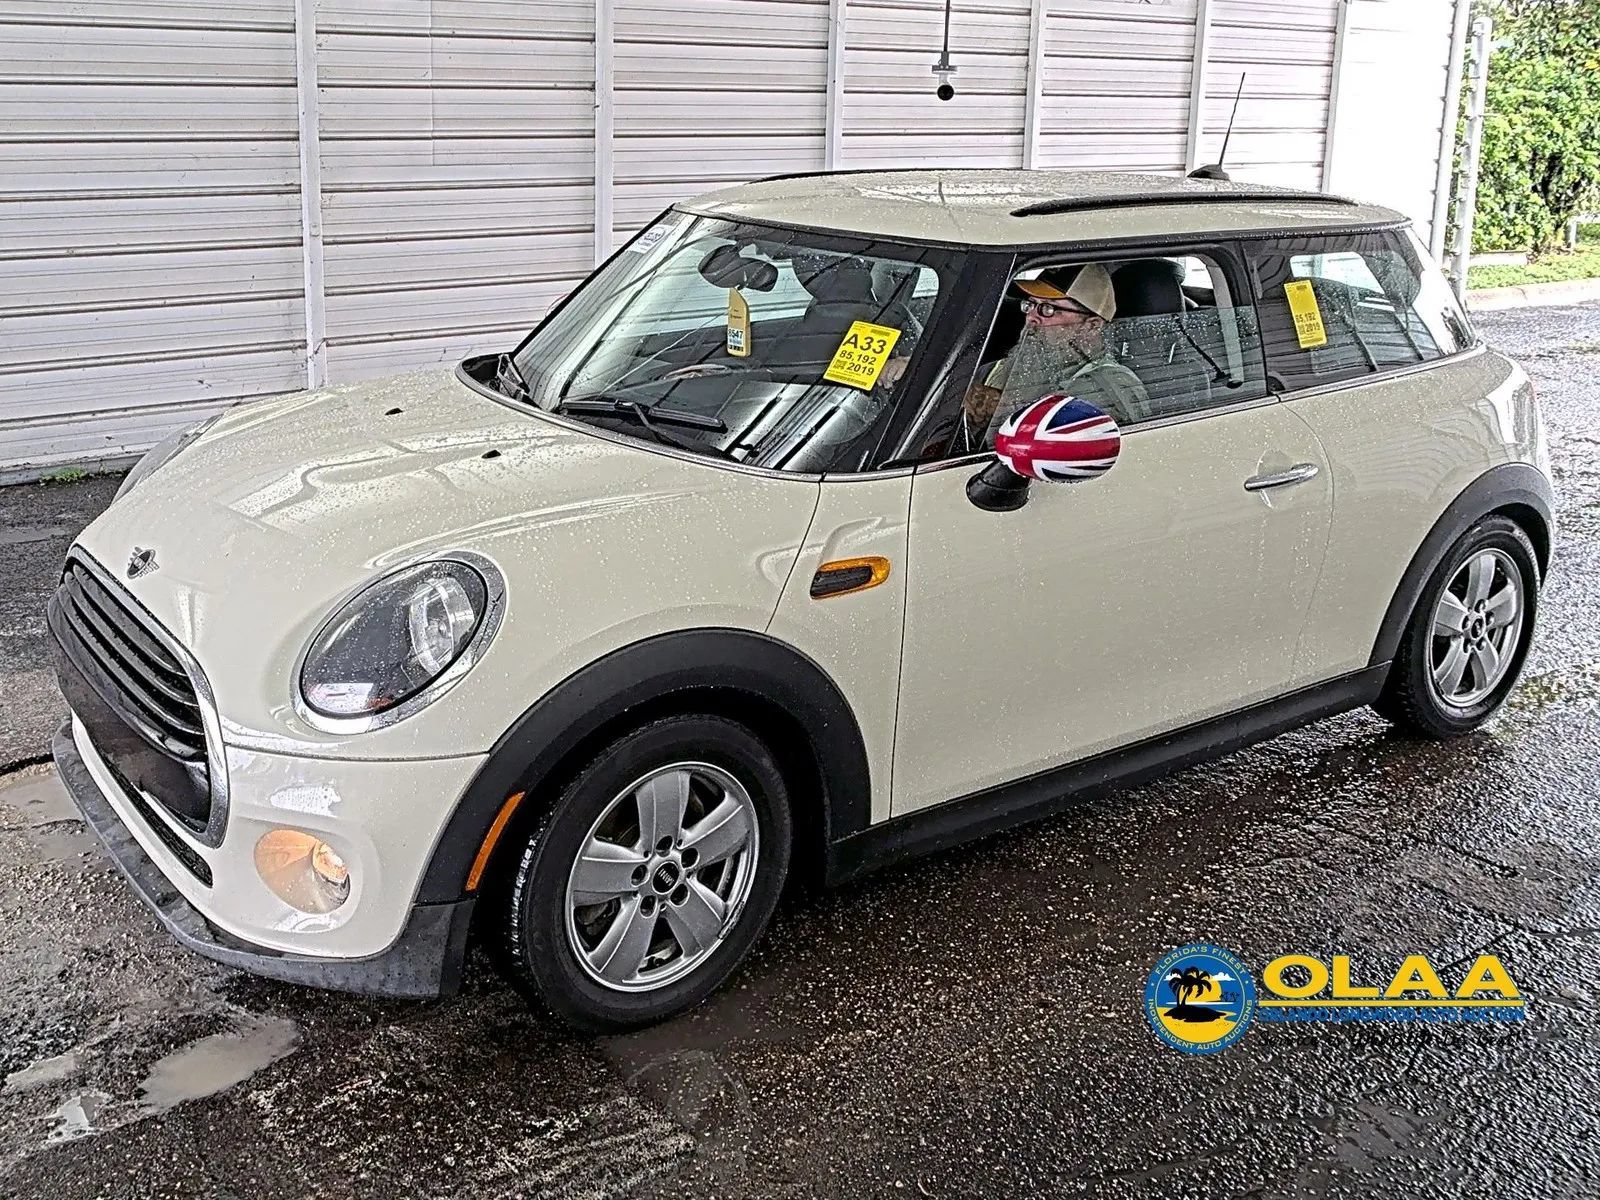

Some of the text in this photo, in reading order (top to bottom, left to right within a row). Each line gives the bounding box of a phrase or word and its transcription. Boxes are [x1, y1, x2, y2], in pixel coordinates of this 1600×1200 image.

[1304, 322, 1321, 332] 2019
[842, 333, 887, 355] A33
[839, 349, 877, 366] 85,192
[846, 362, 875, 377] 2019
